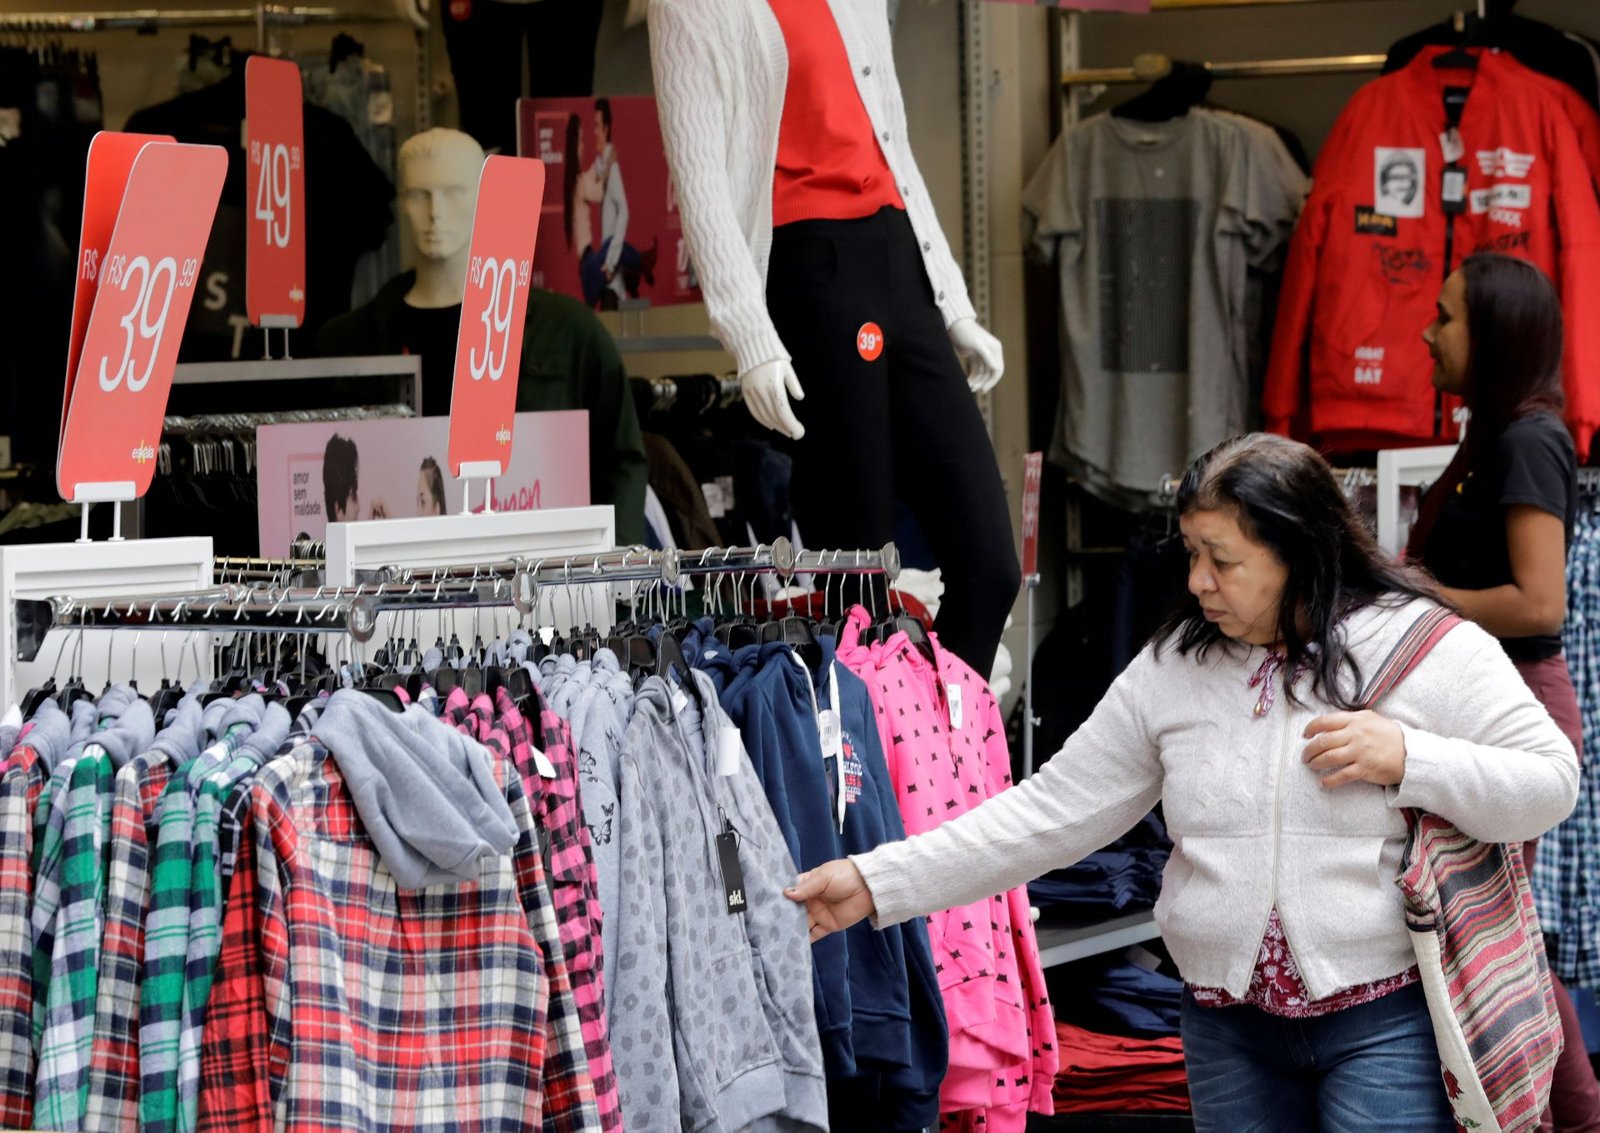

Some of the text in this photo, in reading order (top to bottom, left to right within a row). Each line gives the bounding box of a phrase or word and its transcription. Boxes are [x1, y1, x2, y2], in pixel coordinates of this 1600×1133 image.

[82, 248, 98, 281] R$
[107, 255, 126, 287] R$
[293, 472, 309, 485] amor
